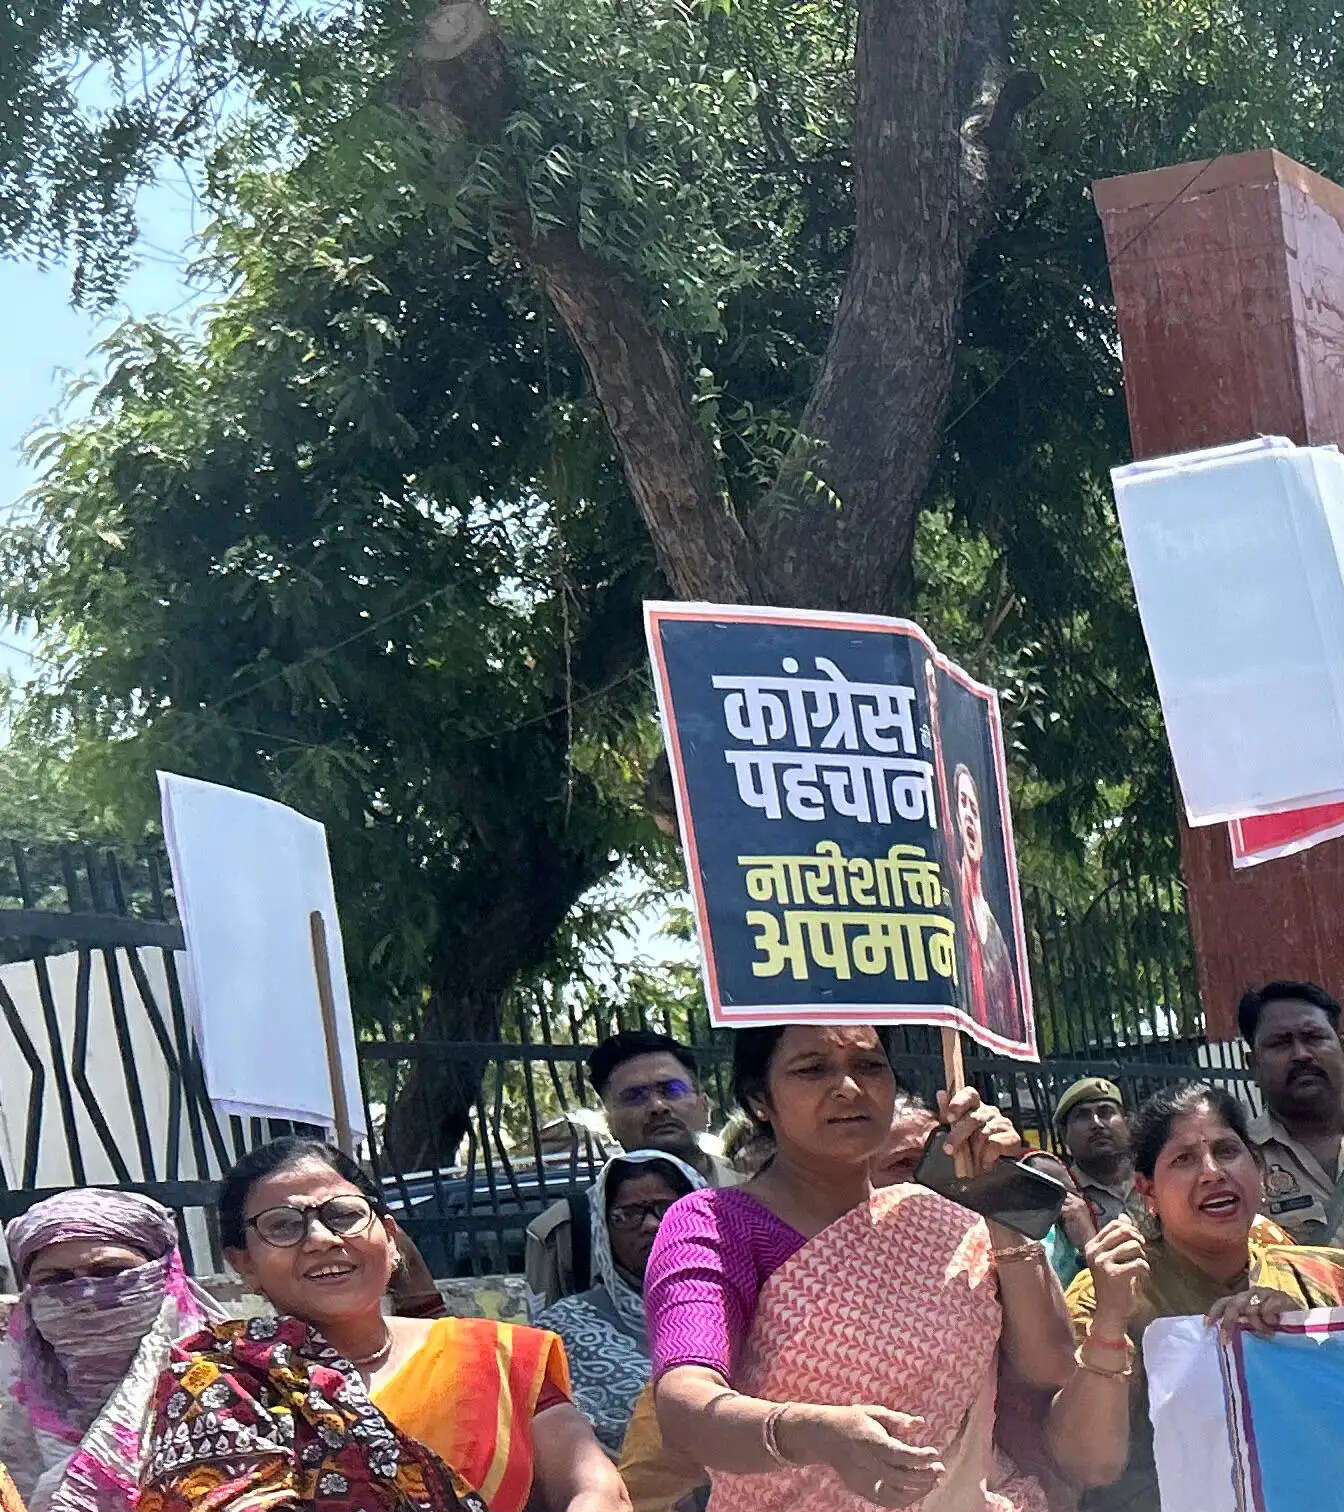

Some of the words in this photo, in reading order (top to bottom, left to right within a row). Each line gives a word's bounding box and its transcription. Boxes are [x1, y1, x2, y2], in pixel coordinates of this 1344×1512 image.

[712, 656, 918, 756] कांग्रेस
[724, 749, 938, 830] पहचान
[737, 839, 941, 909] नारीशक्ति
[746, 909, 958, 986] अपमान
